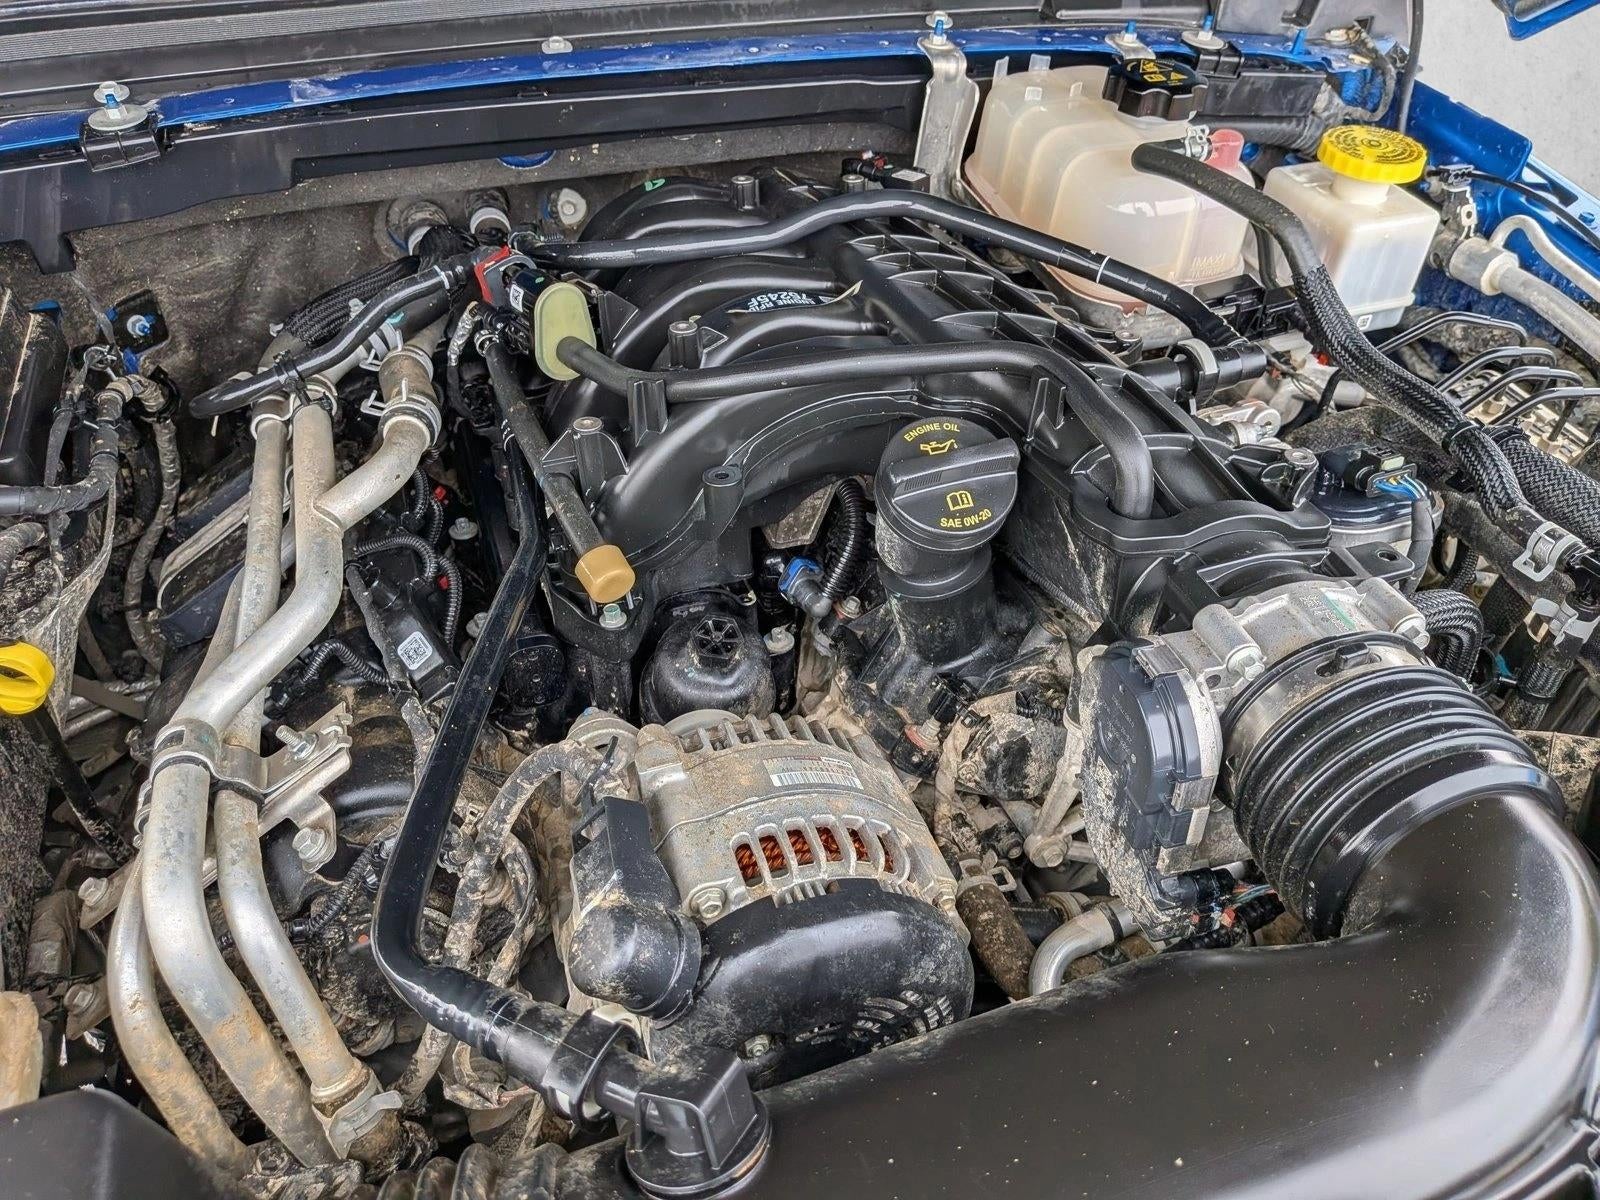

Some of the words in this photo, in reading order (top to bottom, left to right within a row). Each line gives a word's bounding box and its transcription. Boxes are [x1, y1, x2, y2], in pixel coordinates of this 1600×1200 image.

[904, 422, 941, 442] ENGINE
[943, 422, 960, 432] OIL
[940, 517, 962, 528] SAE
[963, 508, 992, 527] 0W-20
